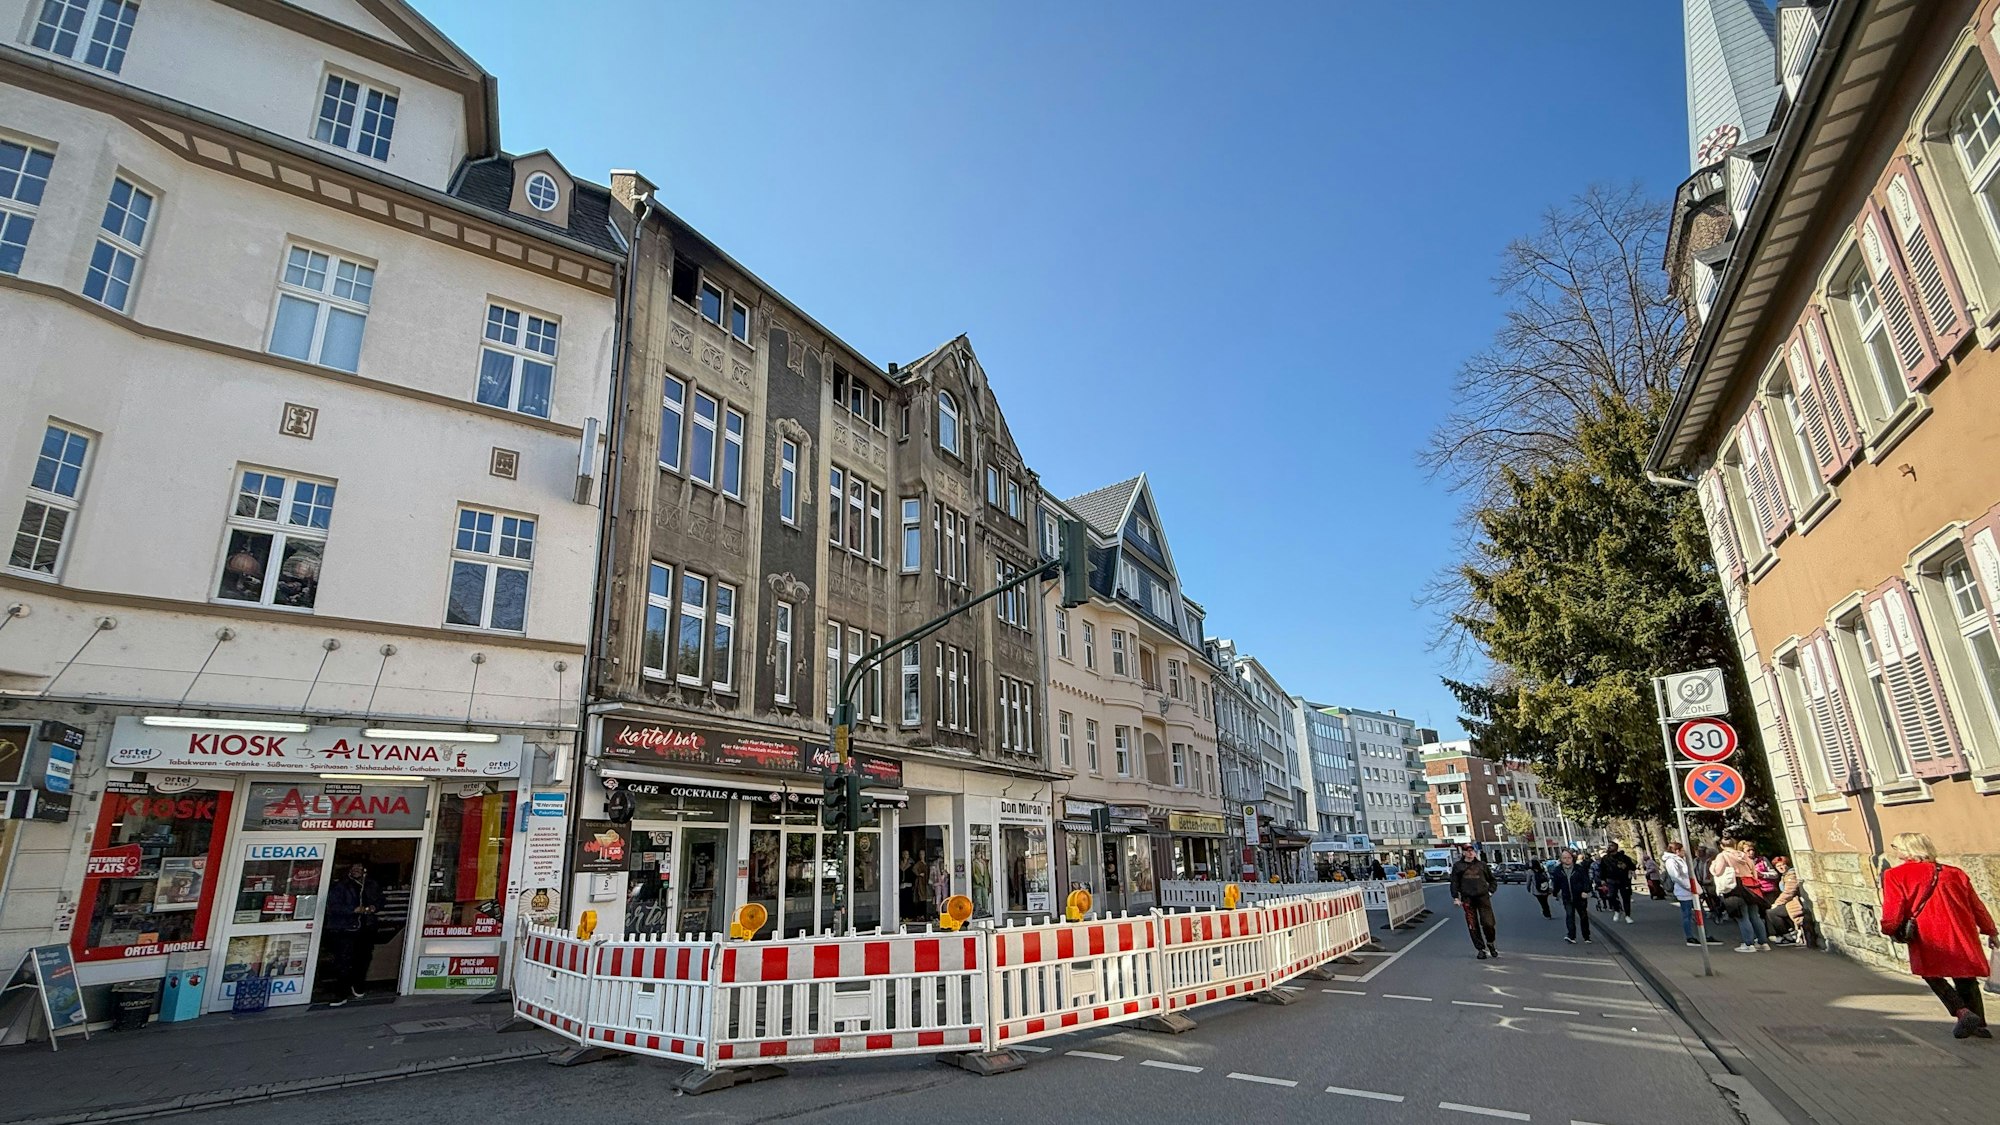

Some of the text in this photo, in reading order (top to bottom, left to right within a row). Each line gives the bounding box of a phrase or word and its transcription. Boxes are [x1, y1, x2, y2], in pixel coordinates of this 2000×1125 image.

[1685, 704, 1712, 715] ZONE
[619, 725, 699, 750] kartel bar
[1689, 729, 1723, 750] 30
[120, 748, 152, 756] ortel
[188, 733, 439, 762] KIOSK ALYANA
[168, 758, 217, 766] Tabakwaren
[628, 783, 659, 795] CAFE
[671, 787, 728, 800] COCKTAILS
[731, 792, 738, 800] &
[266, 788, 411, 815] ALYANA
[1001, 801, 1016, 813] Don
[118, 796, 216, 820] KIOSK
[301, 819, 374, 829] ORTEL MOBILE
[252, 846, 318, 858] LEBARA
[89, 856, 127, 864] INTERNET
[87, 863, 125, 874] FLATS
[424, 926, 472, 936] ORTEL MOBILE
[124, 940, 205, 957] ORTEL MOBILE
